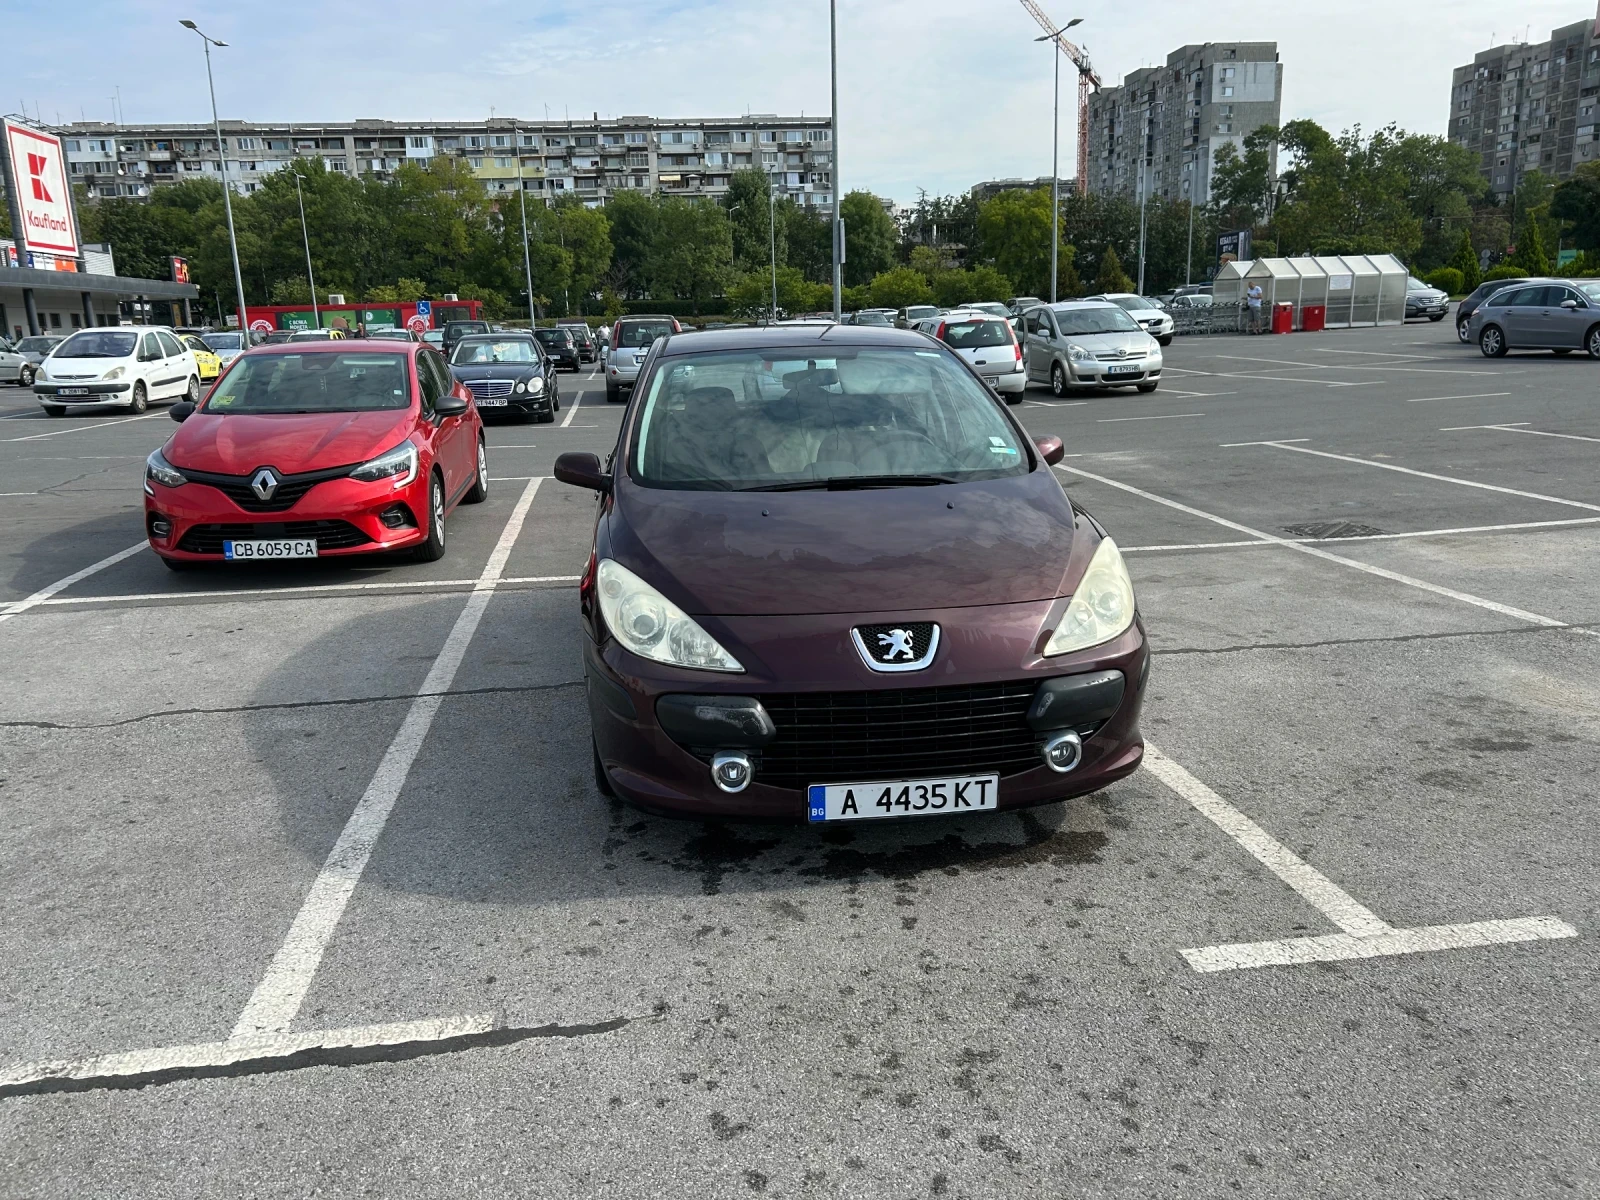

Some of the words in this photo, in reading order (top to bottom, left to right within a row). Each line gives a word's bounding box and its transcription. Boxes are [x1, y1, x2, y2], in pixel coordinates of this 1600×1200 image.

[27, 210, 67, 232] Kaufland
[234, 543, 254, 557] CB
[256, 542, 292, 556] 6059
[294, 542, 314, 556] CA
[811, 807, 825, 817] BG
[841, 789, 859, 815] A
[875, 783, 948, 812] 4435
[954, 779, 993, 808] KT
